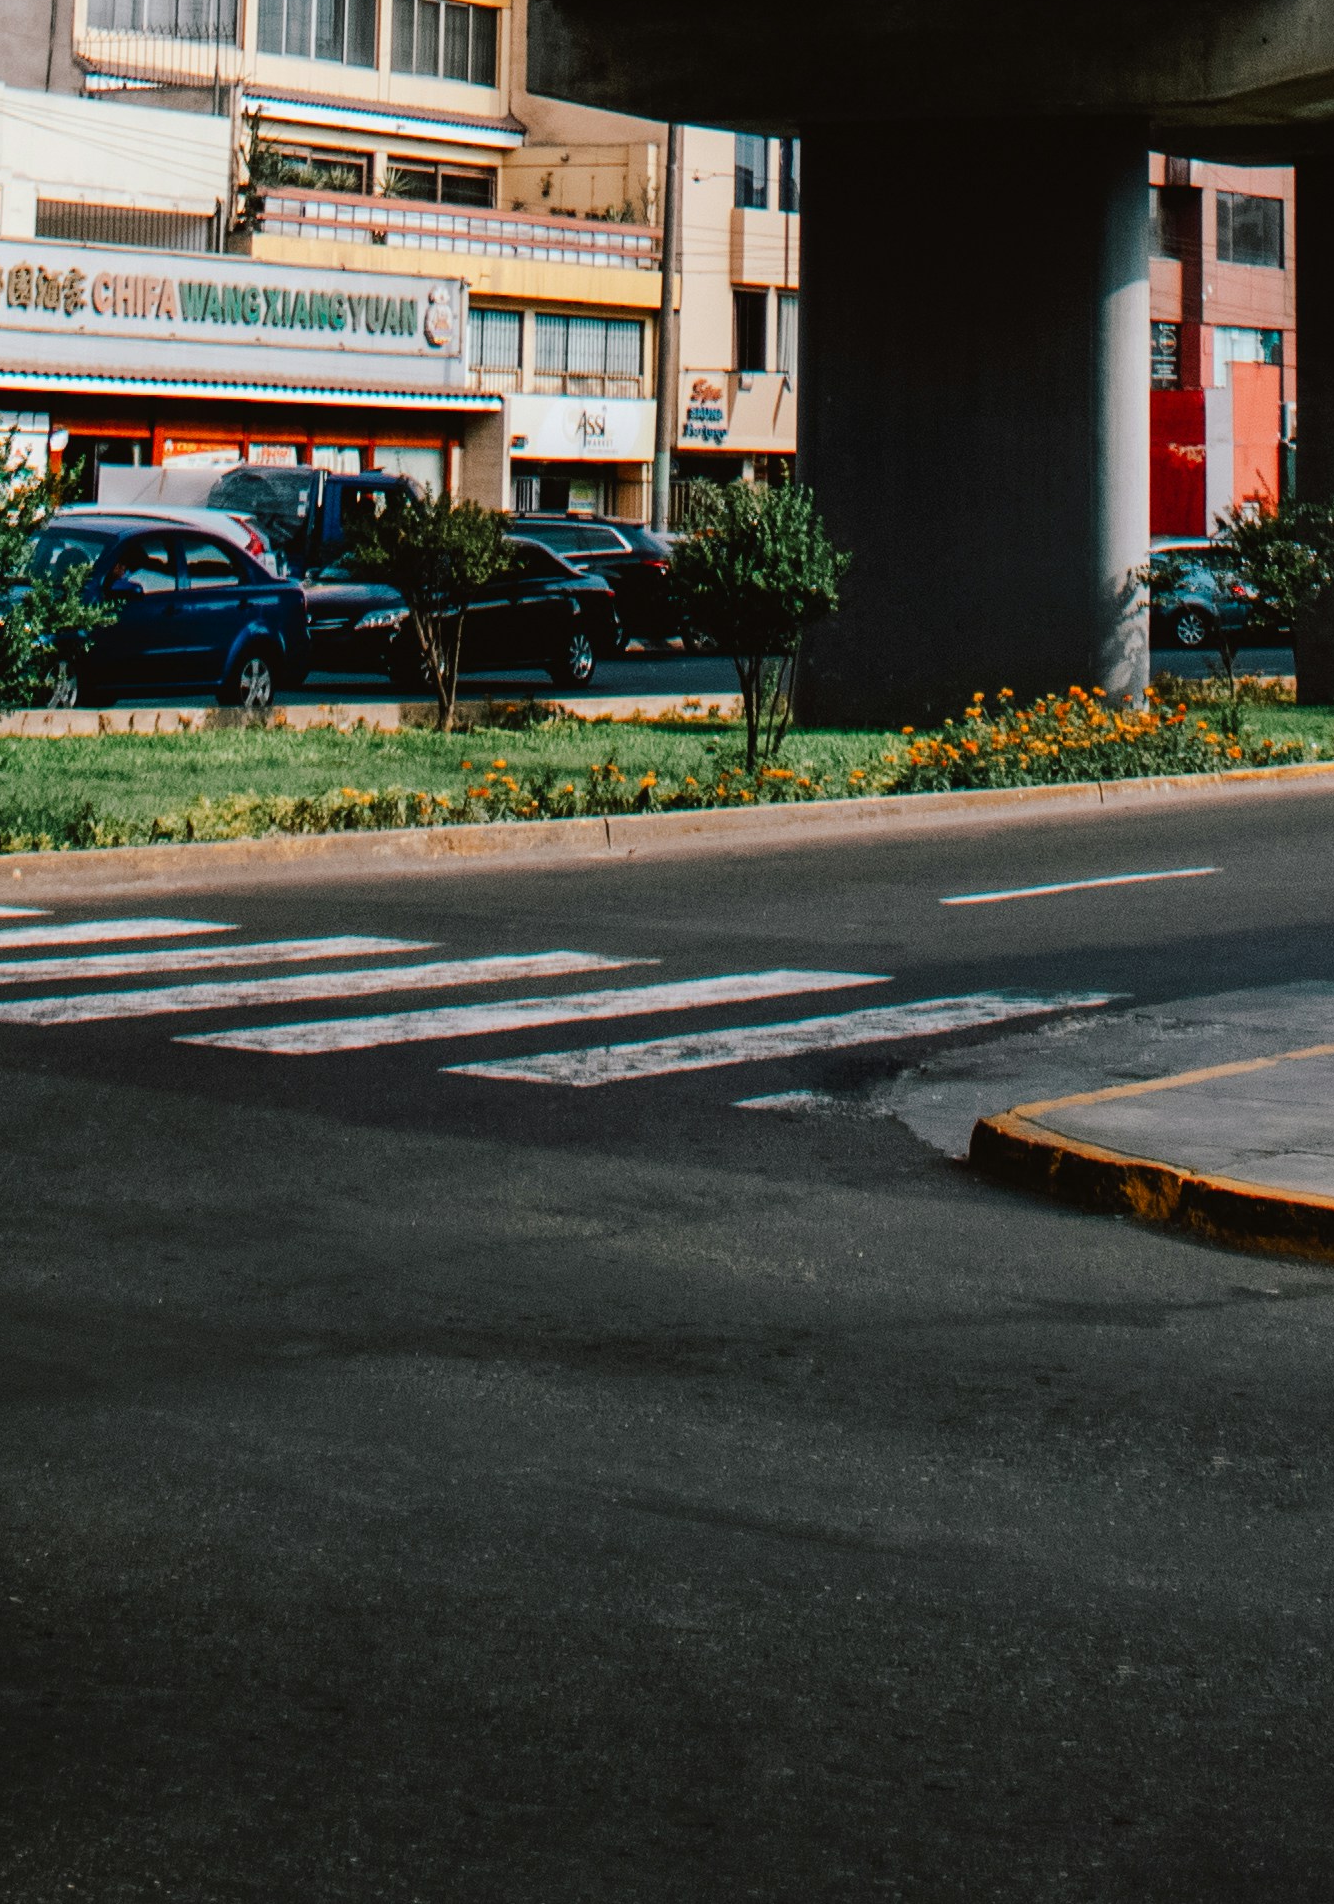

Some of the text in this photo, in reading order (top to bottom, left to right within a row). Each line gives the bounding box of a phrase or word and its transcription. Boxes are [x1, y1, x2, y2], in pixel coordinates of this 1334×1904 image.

[91, 272, 418, 337] CHIFA WANG XIANG YUAN
